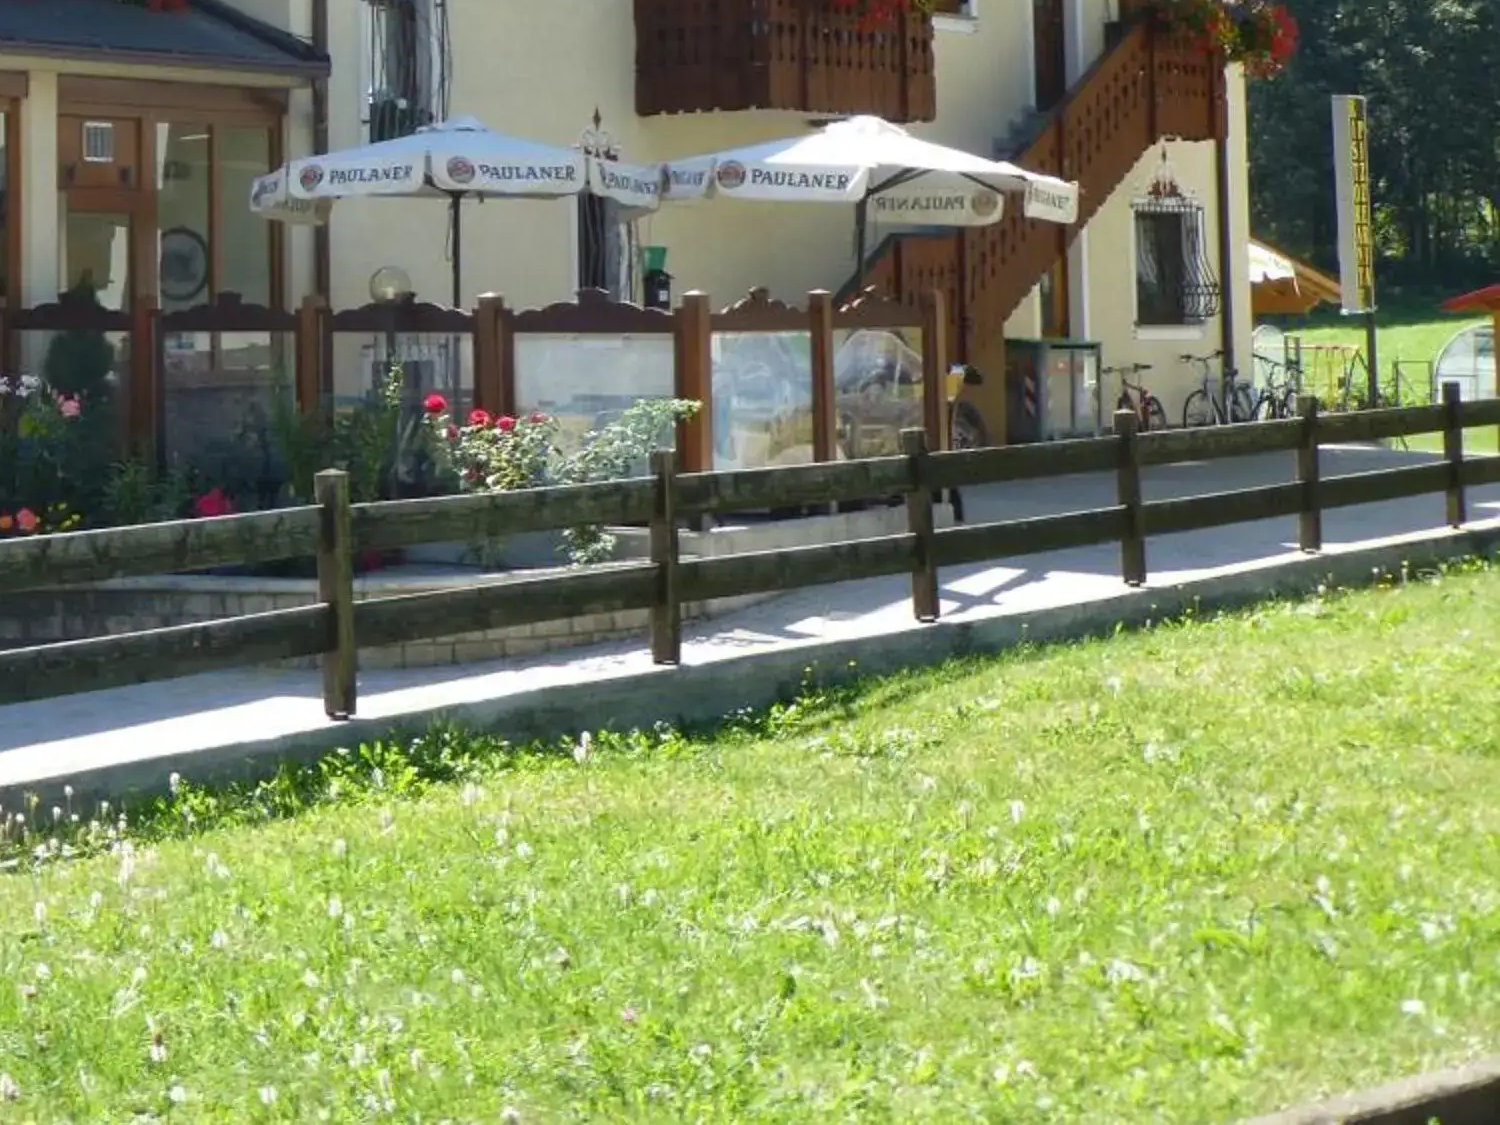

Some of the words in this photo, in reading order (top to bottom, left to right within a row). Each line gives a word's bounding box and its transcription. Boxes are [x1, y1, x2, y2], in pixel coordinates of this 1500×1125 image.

[328, 165, 413, 184] PAULANER
[478, 164, 576, 181] PAULANER
[751, 168, 849, 190] PAULANER
